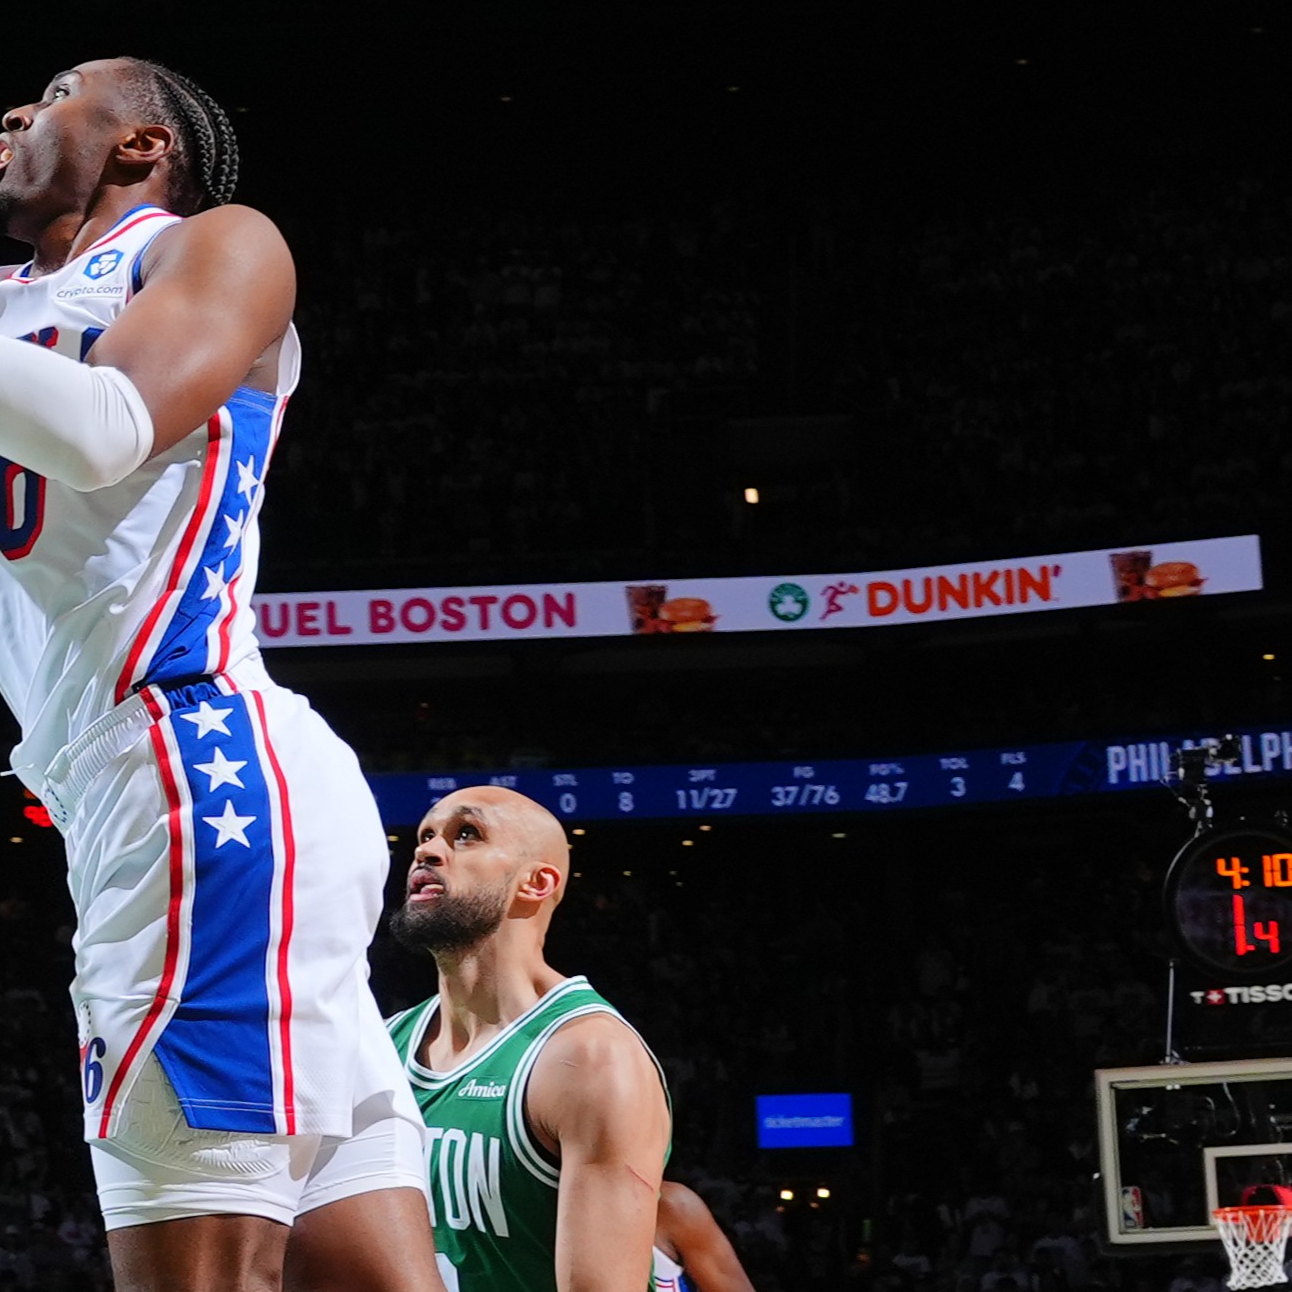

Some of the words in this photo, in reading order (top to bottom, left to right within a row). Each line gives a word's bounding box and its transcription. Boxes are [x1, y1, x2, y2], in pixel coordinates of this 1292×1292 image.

[57, 284, 123, 301] crypto.com
[369, 592, 577, 634] BOSTON
[559, 792, 577, 813] 0
[618, 791, 635, 813] 8
[676, 788, 738, 810] 11/27
[771, 784, 840, 807] 37/76
[864, 781, 908, 804] 48.7
[950, 776, 966, 797] 3
[1008, 771, 1025, 792] 4
[1232, 894, 1281, 955] 1.4
[458, 1078, 506, 1098] Amica
